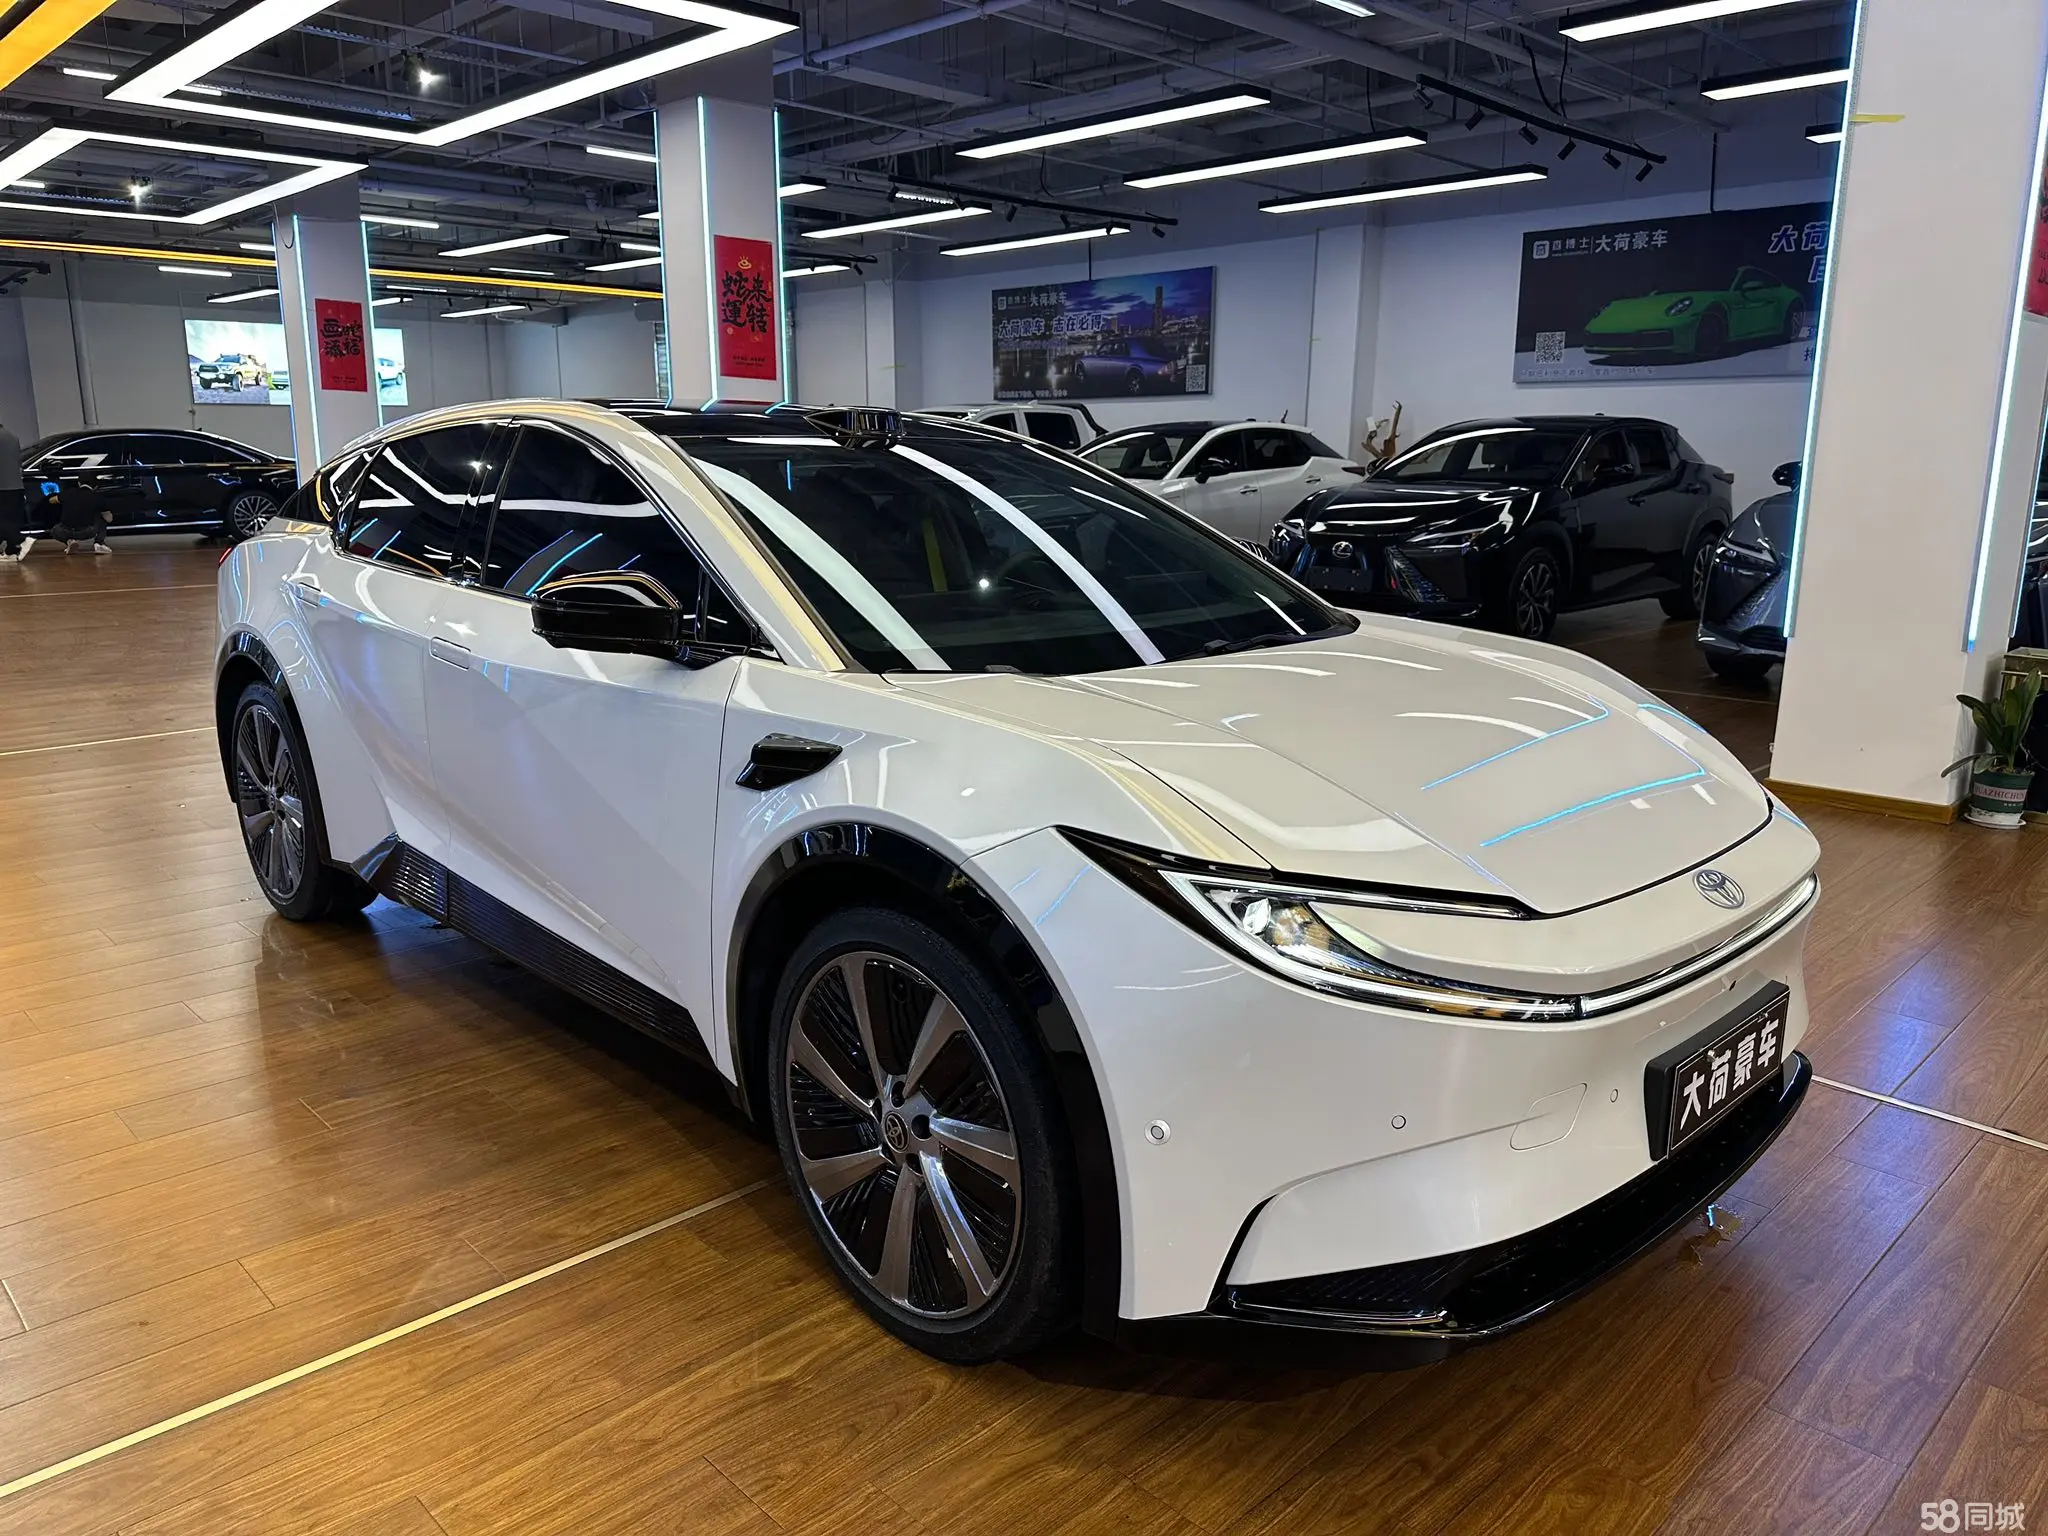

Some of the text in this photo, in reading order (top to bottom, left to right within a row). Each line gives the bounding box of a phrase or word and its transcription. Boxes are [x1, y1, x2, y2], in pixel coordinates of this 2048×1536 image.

[1594, 228, 1669, 254] 大荷豪车
[1052, 313, 1103, 334] 志在必得
[1679, 1018, 1779, 1131] 大荷豪车
